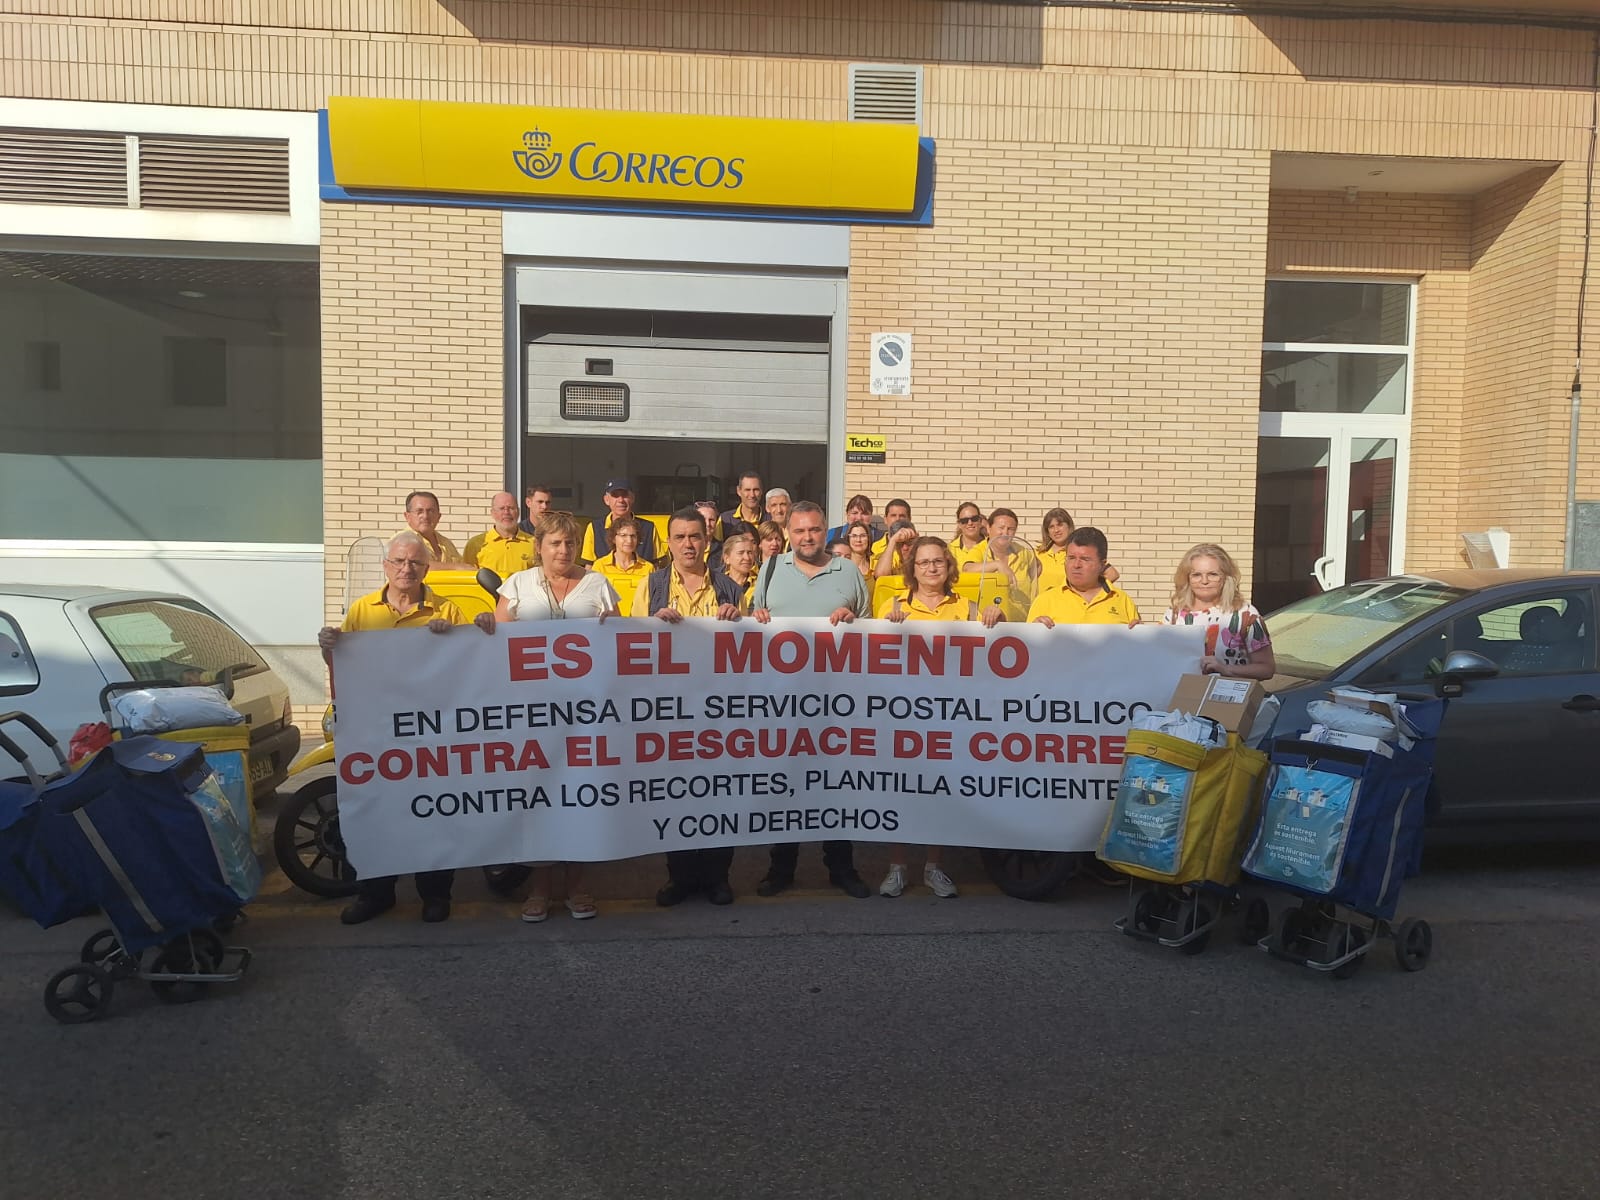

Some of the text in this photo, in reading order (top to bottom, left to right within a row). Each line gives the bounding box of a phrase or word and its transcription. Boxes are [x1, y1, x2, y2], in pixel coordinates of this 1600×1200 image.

[570, 142, 745, 188] CORREOS
[508, 630, 1030, 681] ES EL MOMENTO
[393, 709, 442, 738] EN
[455, 699, 621, 733] DEFENSA
[631, 696, 695, 722] DEL
[704, 693, 856, 719] SERVICIO
[867, 695, 993, 722] POSTAL
[339, 727, 1126, 785] CONTRA EL DESGUACE DE CORRE
[410, 786, 552, 819] CONTRA
[560, 782, 620, 807] LOS
[628, 772, 796, 804] RECORTES,
[804, 769, 952, 796] PLANTILLA
[652, 807, 899, 841] Y CON DERECHOS
